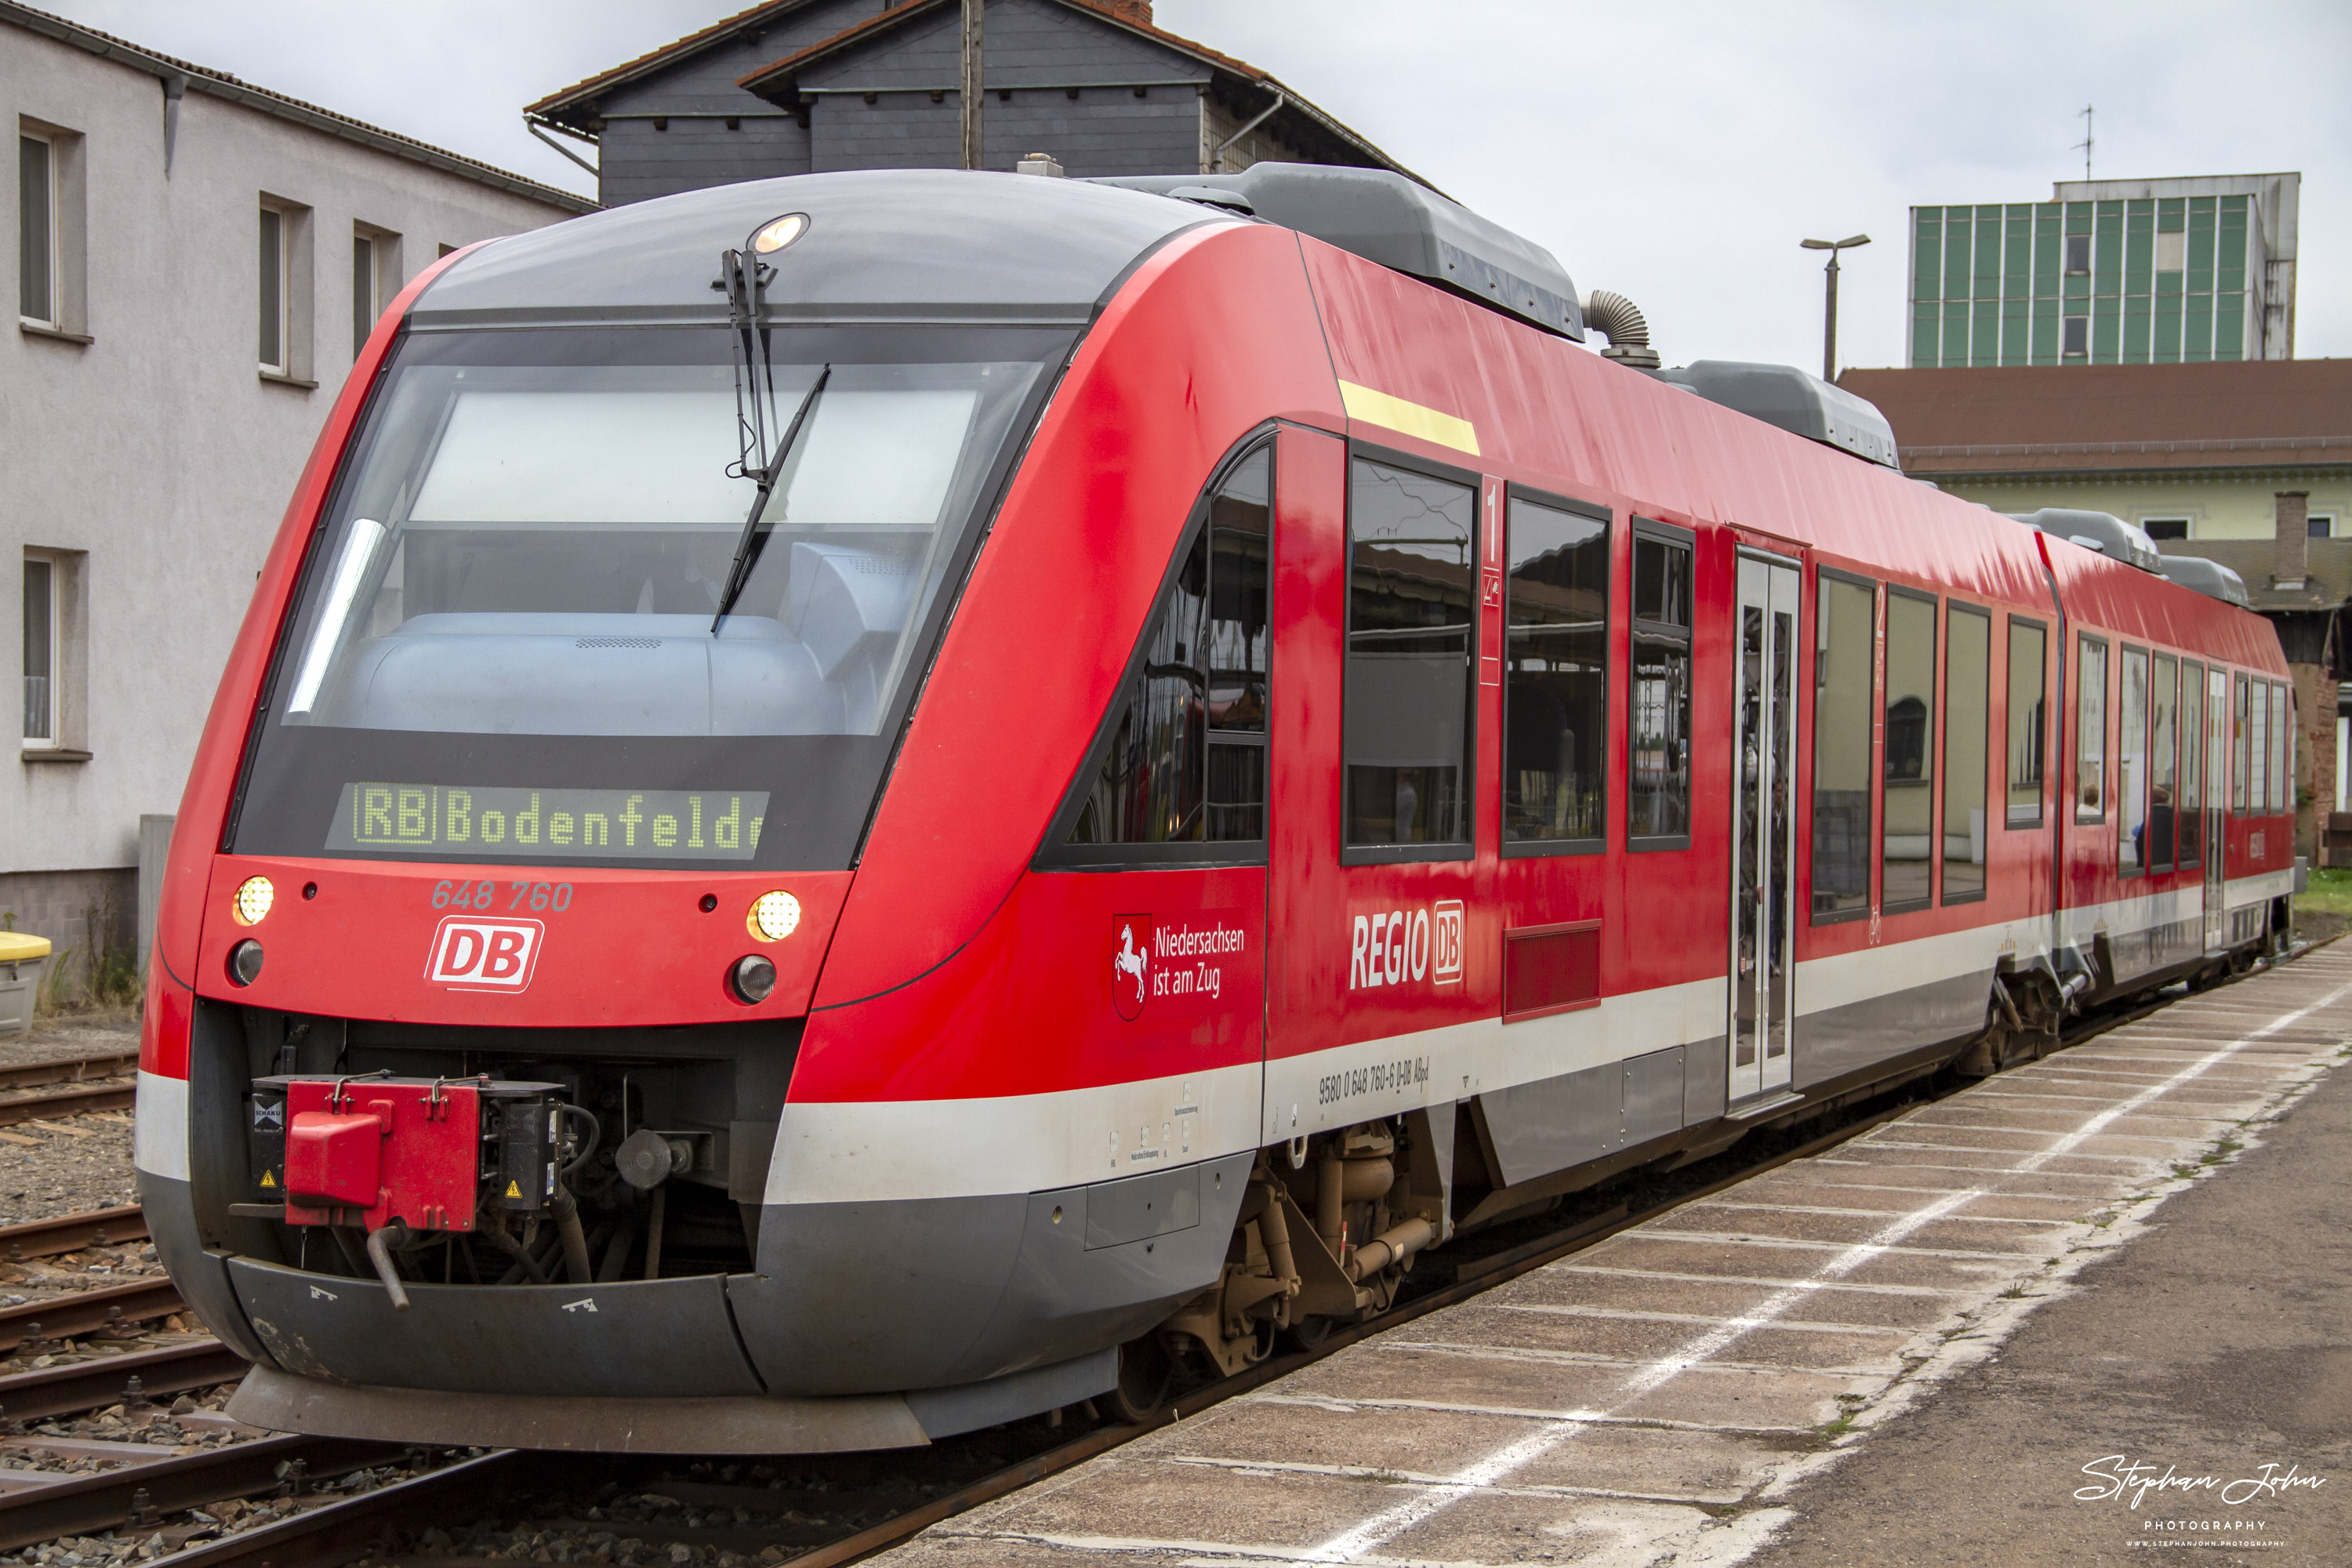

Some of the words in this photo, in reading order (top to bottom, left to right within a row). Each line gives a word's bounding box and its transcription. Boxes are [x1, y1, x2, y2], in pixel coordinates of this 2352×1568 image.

[1487, 484, 1496, 562] 1
[1877, 585, 1884, 637] 2
[364, 788, 426, 837] RB
[431, 880, 495, 909] 648
[508, 883, 573, 911] 760
[439, 929, 526, 978] DB
[1155, 921, 1245, 958] Niedersachsen
[1350, 909, 1429, 990] REGIO
[1437, 916, 1459, 974] DB
[1154, 967, 1170, 996] ist
[1173, 969, 1193, 994] am
[1196, 962, 1220, 999] Zug
[1319, 1073, 1341, 1105] 9580
[1344, 1071, 1350, 1098] 0
[1352, 1067, 1367, 1096] 648
[1370, 1062, 1395, 1094] 760-6
[1396, 1060, 1412, 1094] D-DB
[1414, 1055, 1430, 1094] ABpd
